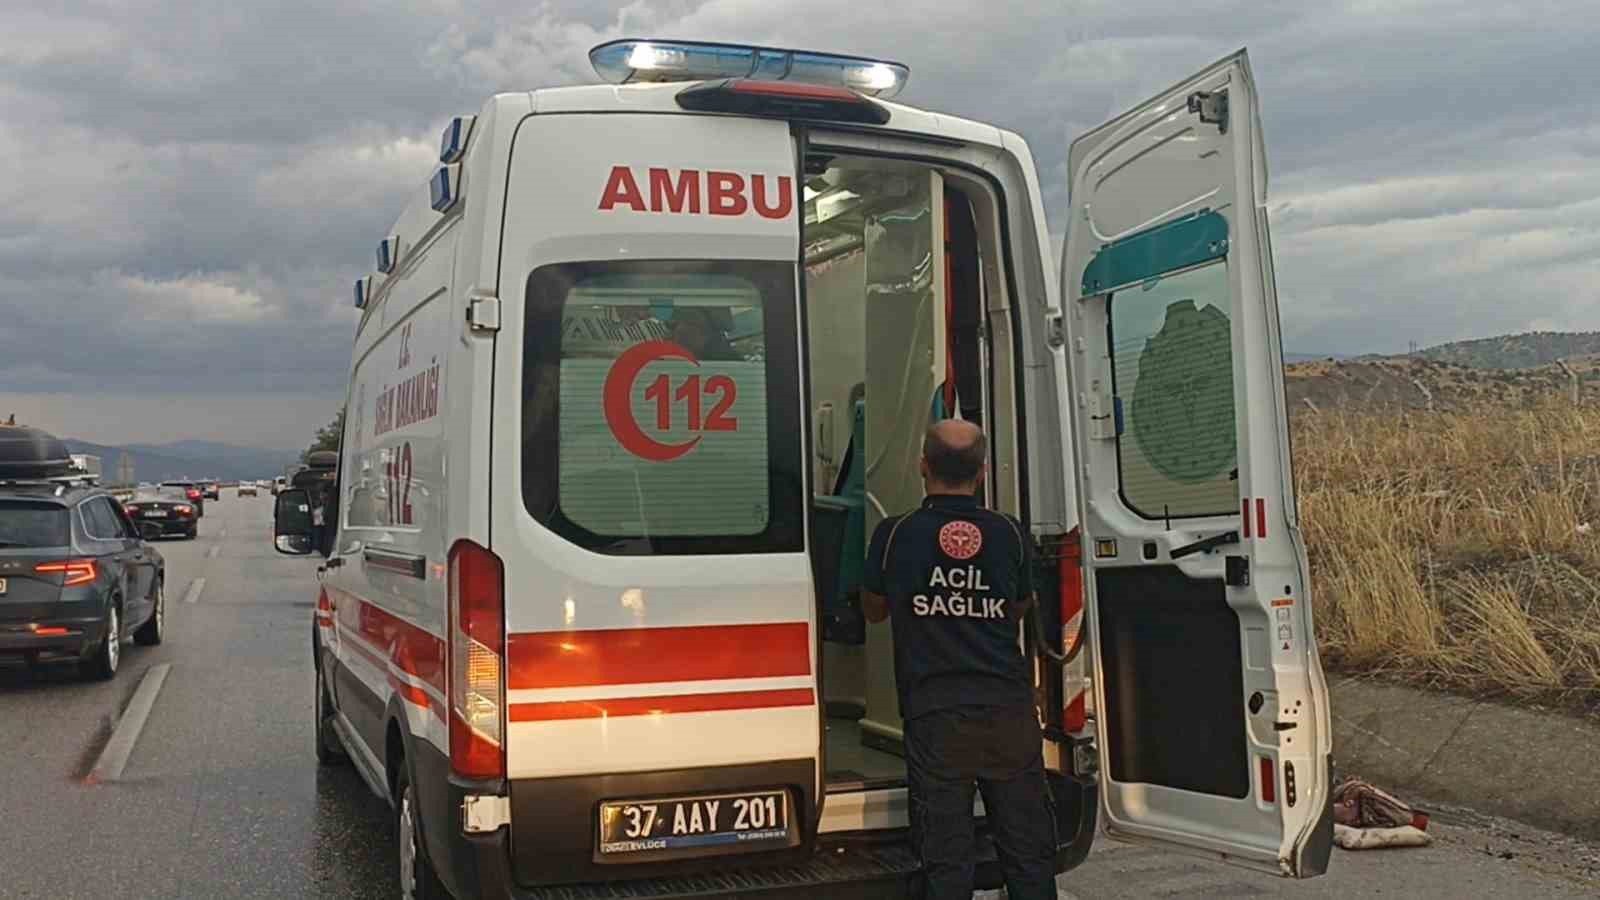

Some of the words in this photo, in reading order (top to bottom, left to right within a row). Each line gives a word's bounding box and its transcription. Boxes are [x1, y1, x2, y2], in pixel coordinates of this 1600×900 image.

[598, 165, 793, 219] AMBU
[644, 373, 738, 431] 112
[386, 441, 413, 526] 112
[929, 564, 991, 591] ACİL
[912, 591, 1007, 619] SAĞLIK
[624, 804, 657, 838] 37
[672, 800, 720, 835] AAY
[732, 796, 777, 831] 201
